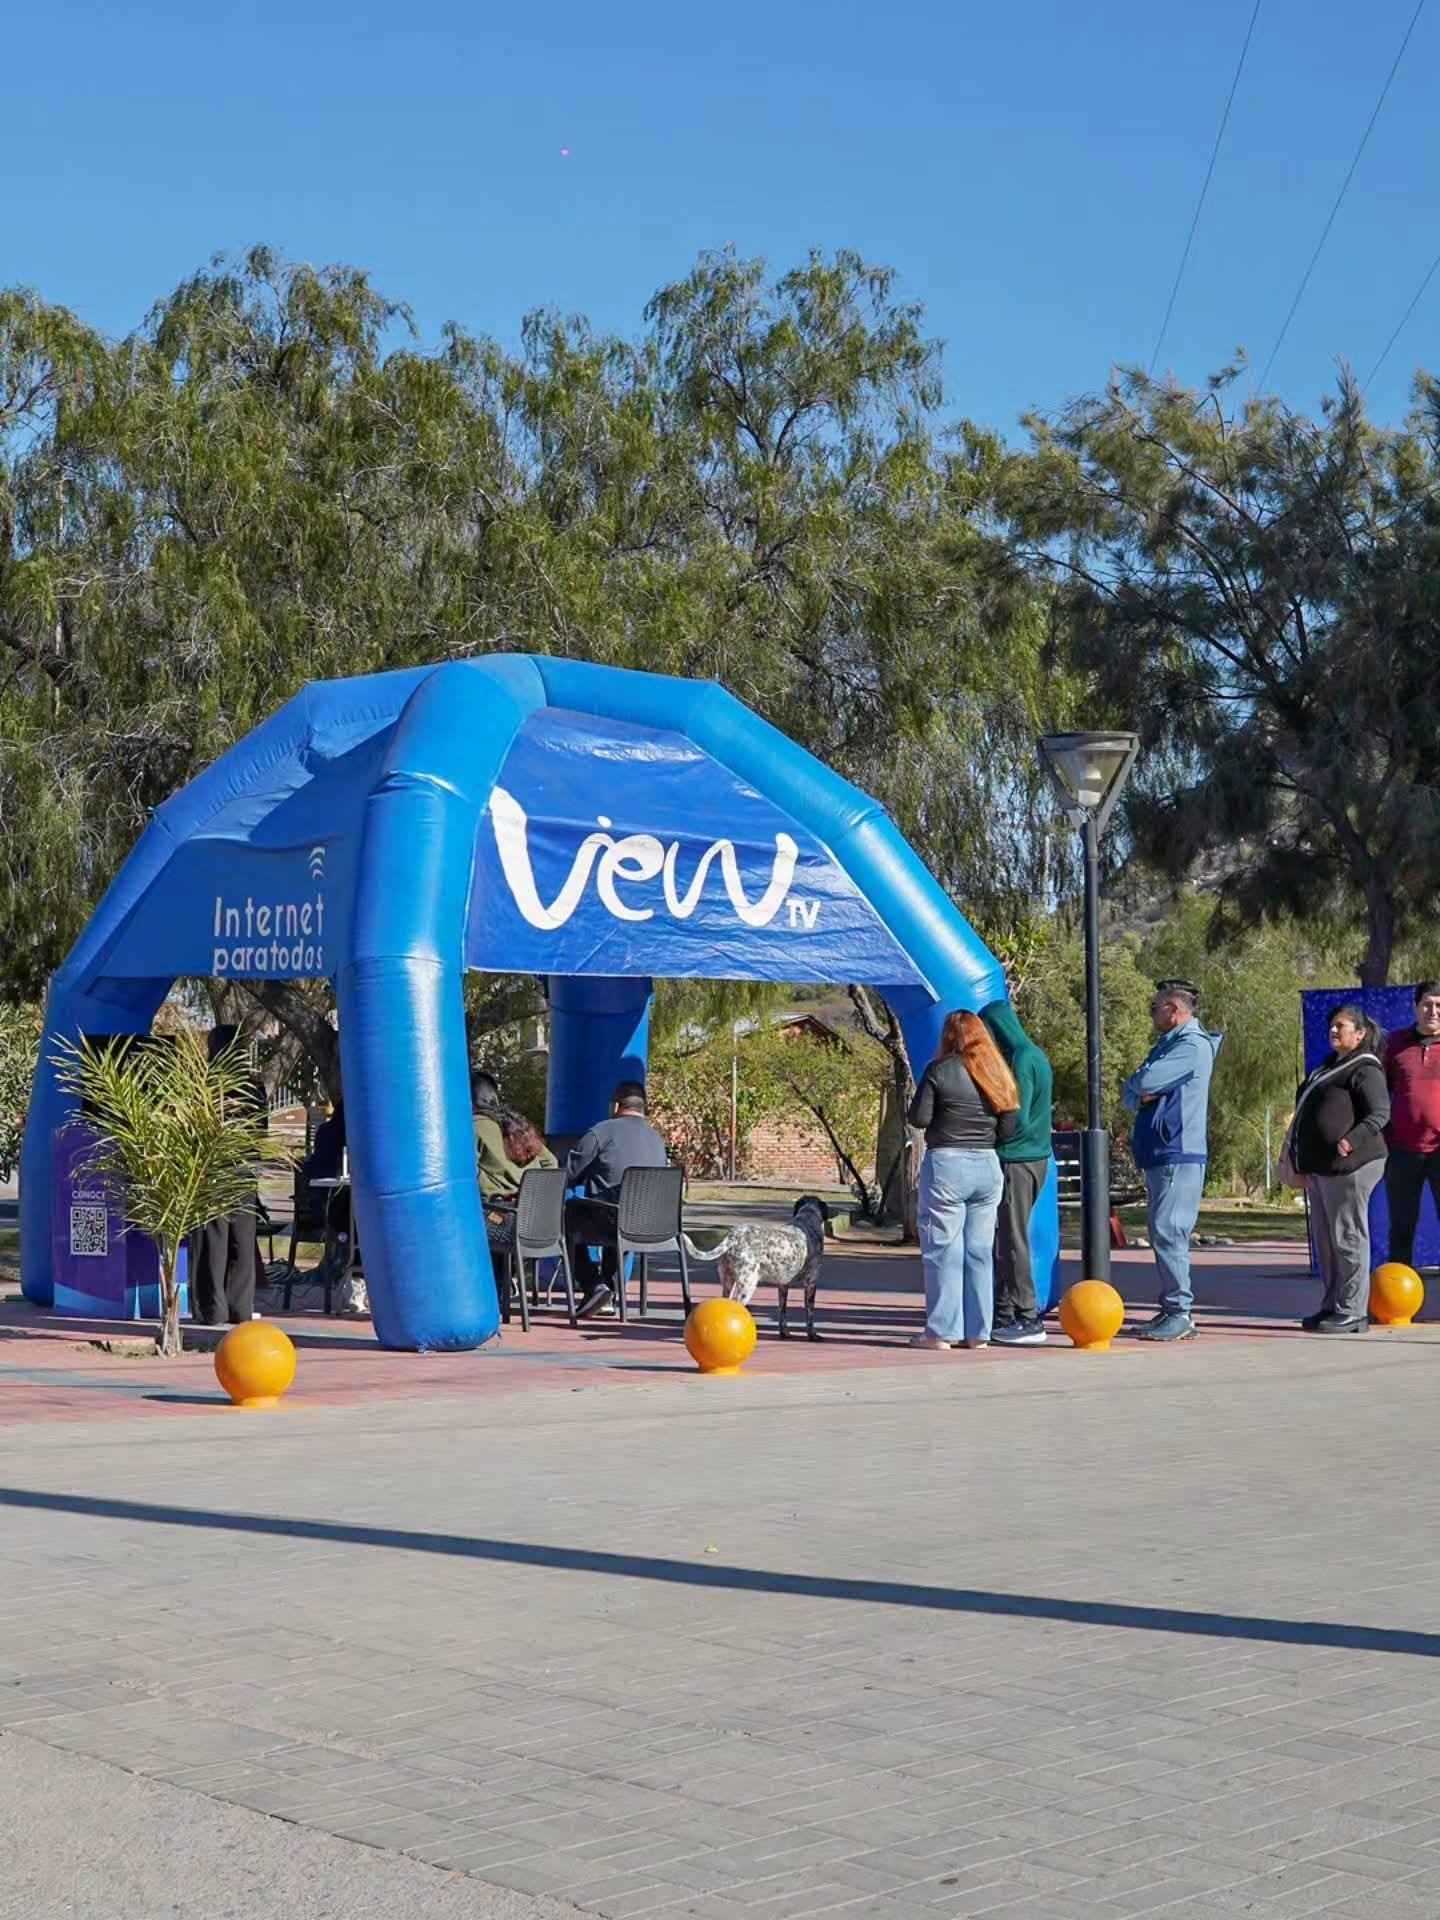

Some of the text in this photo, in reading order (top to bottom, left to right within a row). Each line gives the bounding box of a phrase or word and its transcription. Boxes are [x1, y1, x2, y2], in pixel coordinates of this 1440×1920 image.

[489, 786, 821, 930] View TV
[214, 893, 324, 937] Internet
